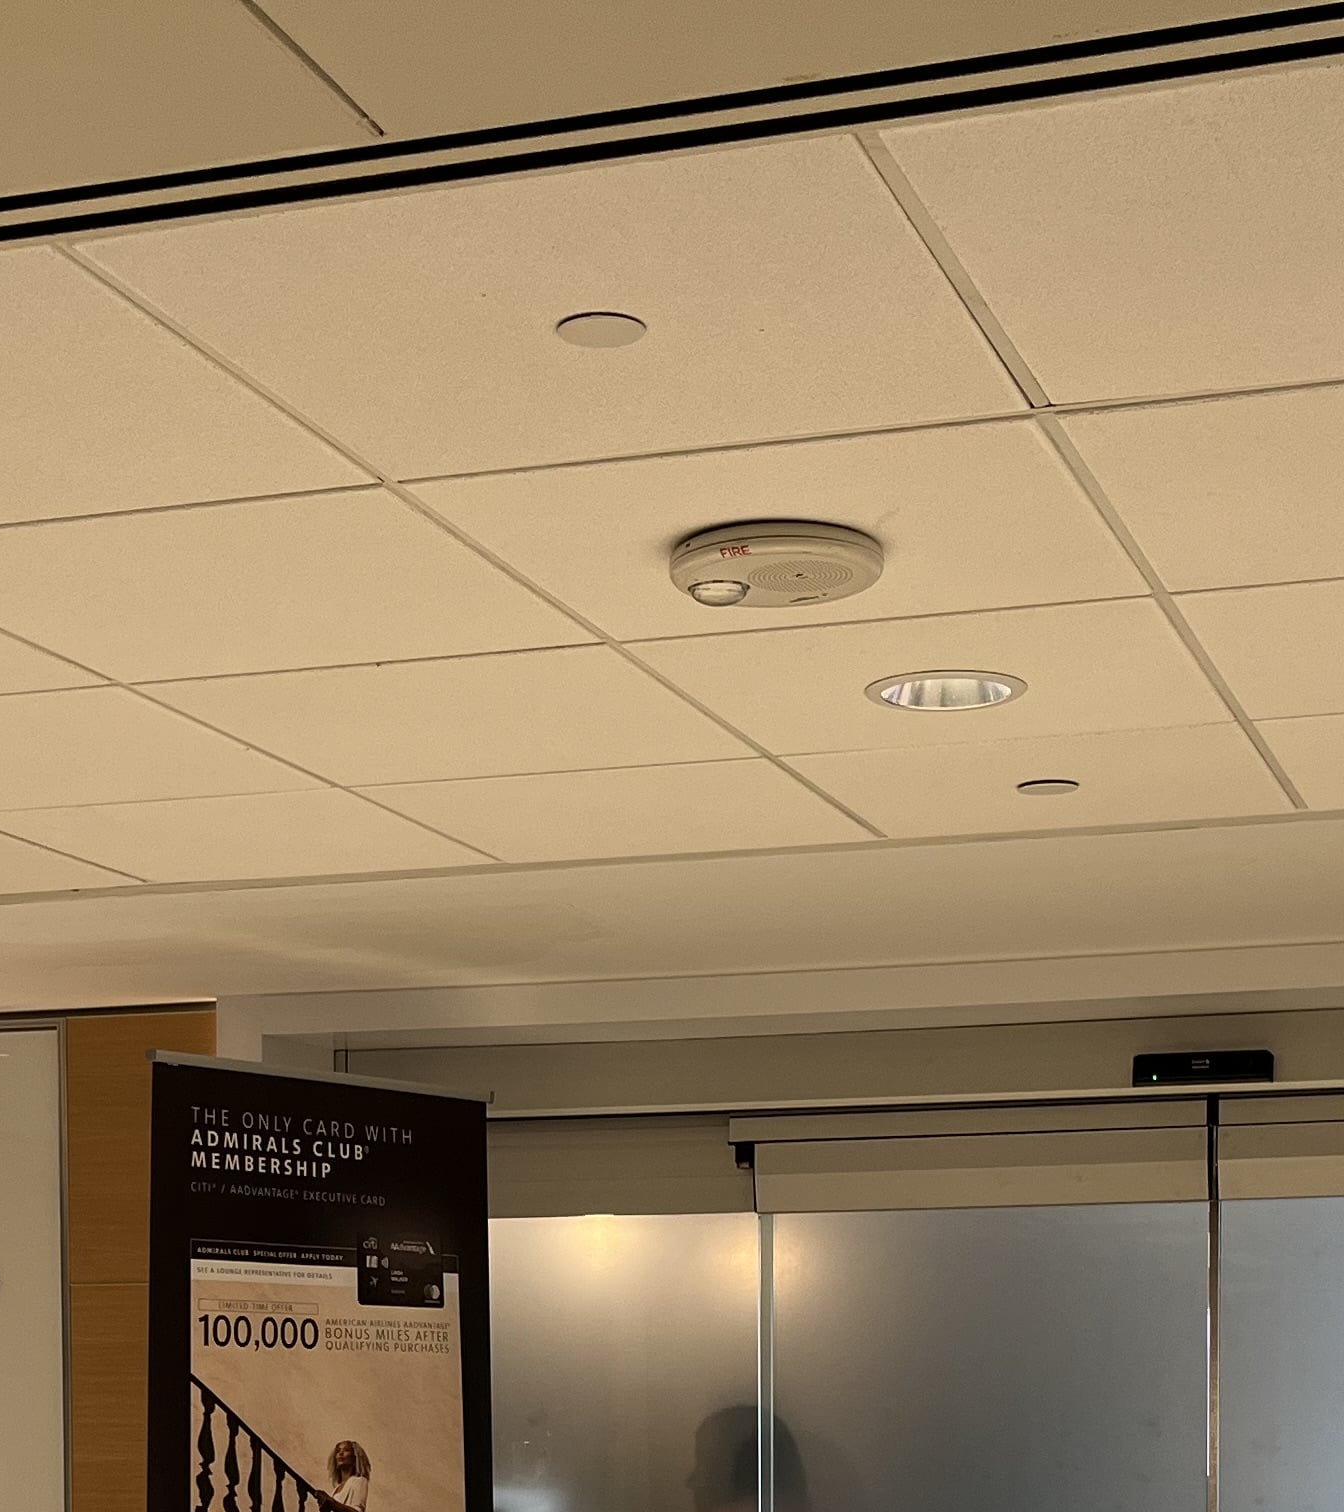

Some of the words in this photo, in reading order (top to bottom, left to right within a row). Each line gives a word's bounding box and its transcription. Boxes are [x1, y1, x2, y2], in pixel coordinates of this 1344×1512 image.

[719, 545, 752, 558] FIRE
[191, 1106, 230, 1127] THE
[242, 1111, 293, 1133] ONLY
[303, 1118, 355, 1139] CARD
[365, 1125, 414, 1145] WITH
[191, 1129, 302, 1155] ADMIRALS
[191, 1151, 332, 1179] MEMBERSHIP
[303, 1190, 358, 1204] EXECUTIVE
[360, 1195, 386, 1206] CARD
[218, 1301, 249, 1310] LIMITED
[252, 1302, 268, 1311] TIME
[271, 1303, 294, 1312] OFFER
[325, 1318, 367, 1327] AMERICAN
[369, 1320, 401, 1328] AIRLINES
[198, 1314, 319, 1352] 100,000
[325, 1327, 370, 1340] BONUS
[375, 1329, 410, 1342] MILES
[415, 1331, 449, 1343] AFTER
[325, 1340, 390, 1352] QUALIFYING
[394, 1342, 450, 1354] PURCHASES
